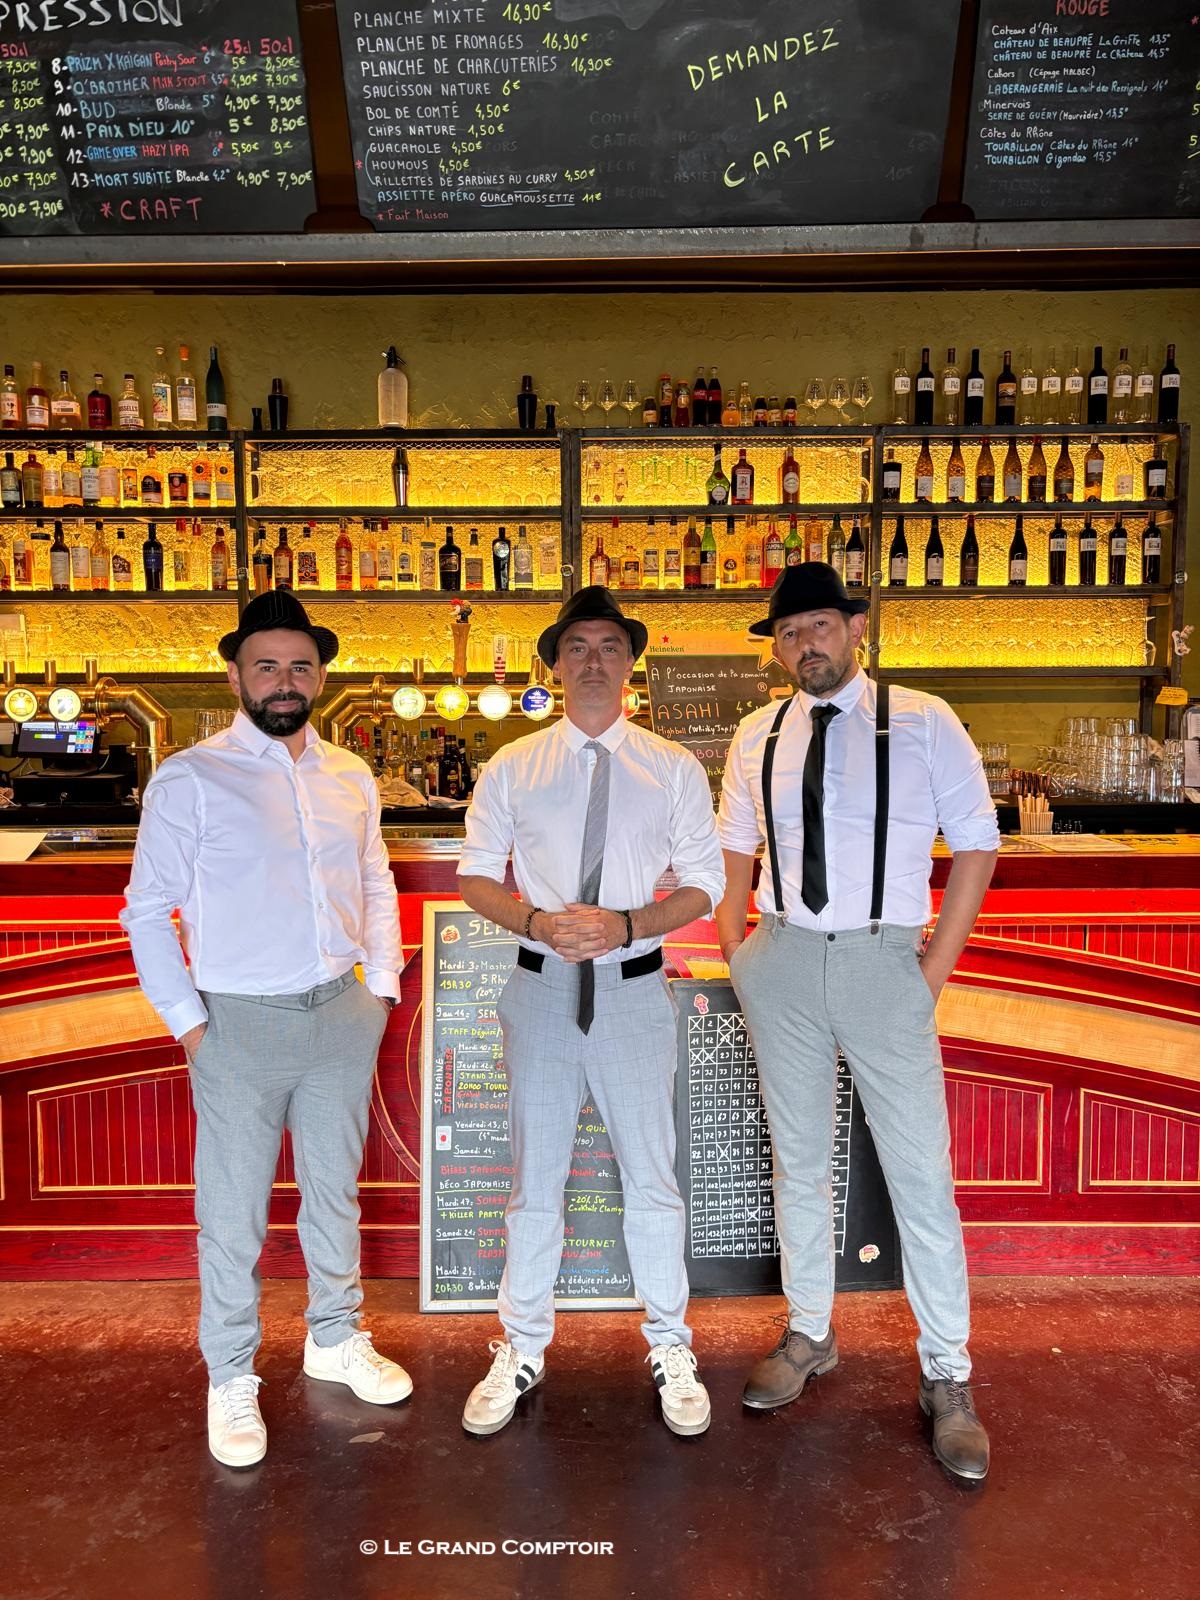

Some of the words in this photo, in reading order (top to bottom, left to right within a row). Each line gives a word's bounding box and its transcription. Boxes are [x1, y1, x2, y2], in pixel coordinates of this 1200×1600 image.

[0, 0, 182, 32] PRESSION
[354, 11, 423, 28] PLANCHE
[433, 8, 486, 24] MIXTE
[502, 1, 552, 24] 16,90€
[1056, 0, 1110, 16] ROUGE
[992, 25, 1026, 37] Coteaux
[224, 39, 252, 54] 25cl
[260, 37, 293, 56] 50cl
[356, 36, 425, 53] PLANCHE
[432, 35, 448, 49] DE
[455, 34, 523, 50] FROMAGES
[542, 32, 588, 51] 16,90€
[994, 37, 1035, 49] CHÂTEAU
[1039, 39, 1049, 47] DE
[1053, 33, 1094, 47] BEAUPRÉ
[361, 59, 426, 77] PLANCHE
[434, 58, 450, 73] DE
[457, 50, 557, 75] CHARCUTERIES
[571, 57, 612, 77] 16,90€
[687, 27, 840, 91] DEMANDEZ
[1037, 51, 1047, 60] DE
[176, 75, 206, 87] STOUT
[987, 67, 1015, 79] Cahors
[363, 81, 432, 99] SAUCISSON
[441, 82, 491, 96] NATURE
[502, 79, 520, 96] 6€
[156, 97, 193, 112] Blonde
[266, 95, 303, 114] 7,90€
[366, 106, 391, 121] BOL
[395, 106, 411, 120] DE
[416, 101, 460, 119] COMTÉ
[474, 103, 510, 121] 4,50€
[755, 90, 788, 123] LA
[983, 99, 1031, 110] Minervois
[988, 111, 1013, 121] SERRE
[1016, 111, 1026, 120] DE
[1029, 107, 1058, 120] GUÉRY
[129, 120, 165, 137] DIEU
[368, 124, 402, 137] CHIPS
[409, 125, 457, 136] NATURE
[980, 127, 1007, 139] Côtes
[1011, 127, 1021, 138] du
[1026, 126, 1053, 138] Rhône
[141, 144, 168, 158] HAZY
[370, 142, 441, 153] GUACAMOLE
[723, 126, 835, 188] CARTE
[372, 160, 429, 171] HOUMOUS
[176, 170, 210, 183] Blanche
[236, 169, 271, 188] 4,90€
[277, 170, 312, 191] 7,90€
[374, 173, 433, 187] RILLETTES
[440, 177, 453, 187] DE
[458, 171, 504, 186] SARDINES
[508, 174, 522, 185] AU
[526, 172, 558, 184] CURRY
[377, 188, 435, 203] ASSIETTE
[441, 189, 475, 202] APÉRO
[480, 192, 575, 203] GUACAMOUSSETTE
[119, 198, 203, 221] CRAFT
[718, 670, 727, 678] de
[668, 684, 716, 693] JAPONAISE
[658, 697, 720, 720] ASAHI
